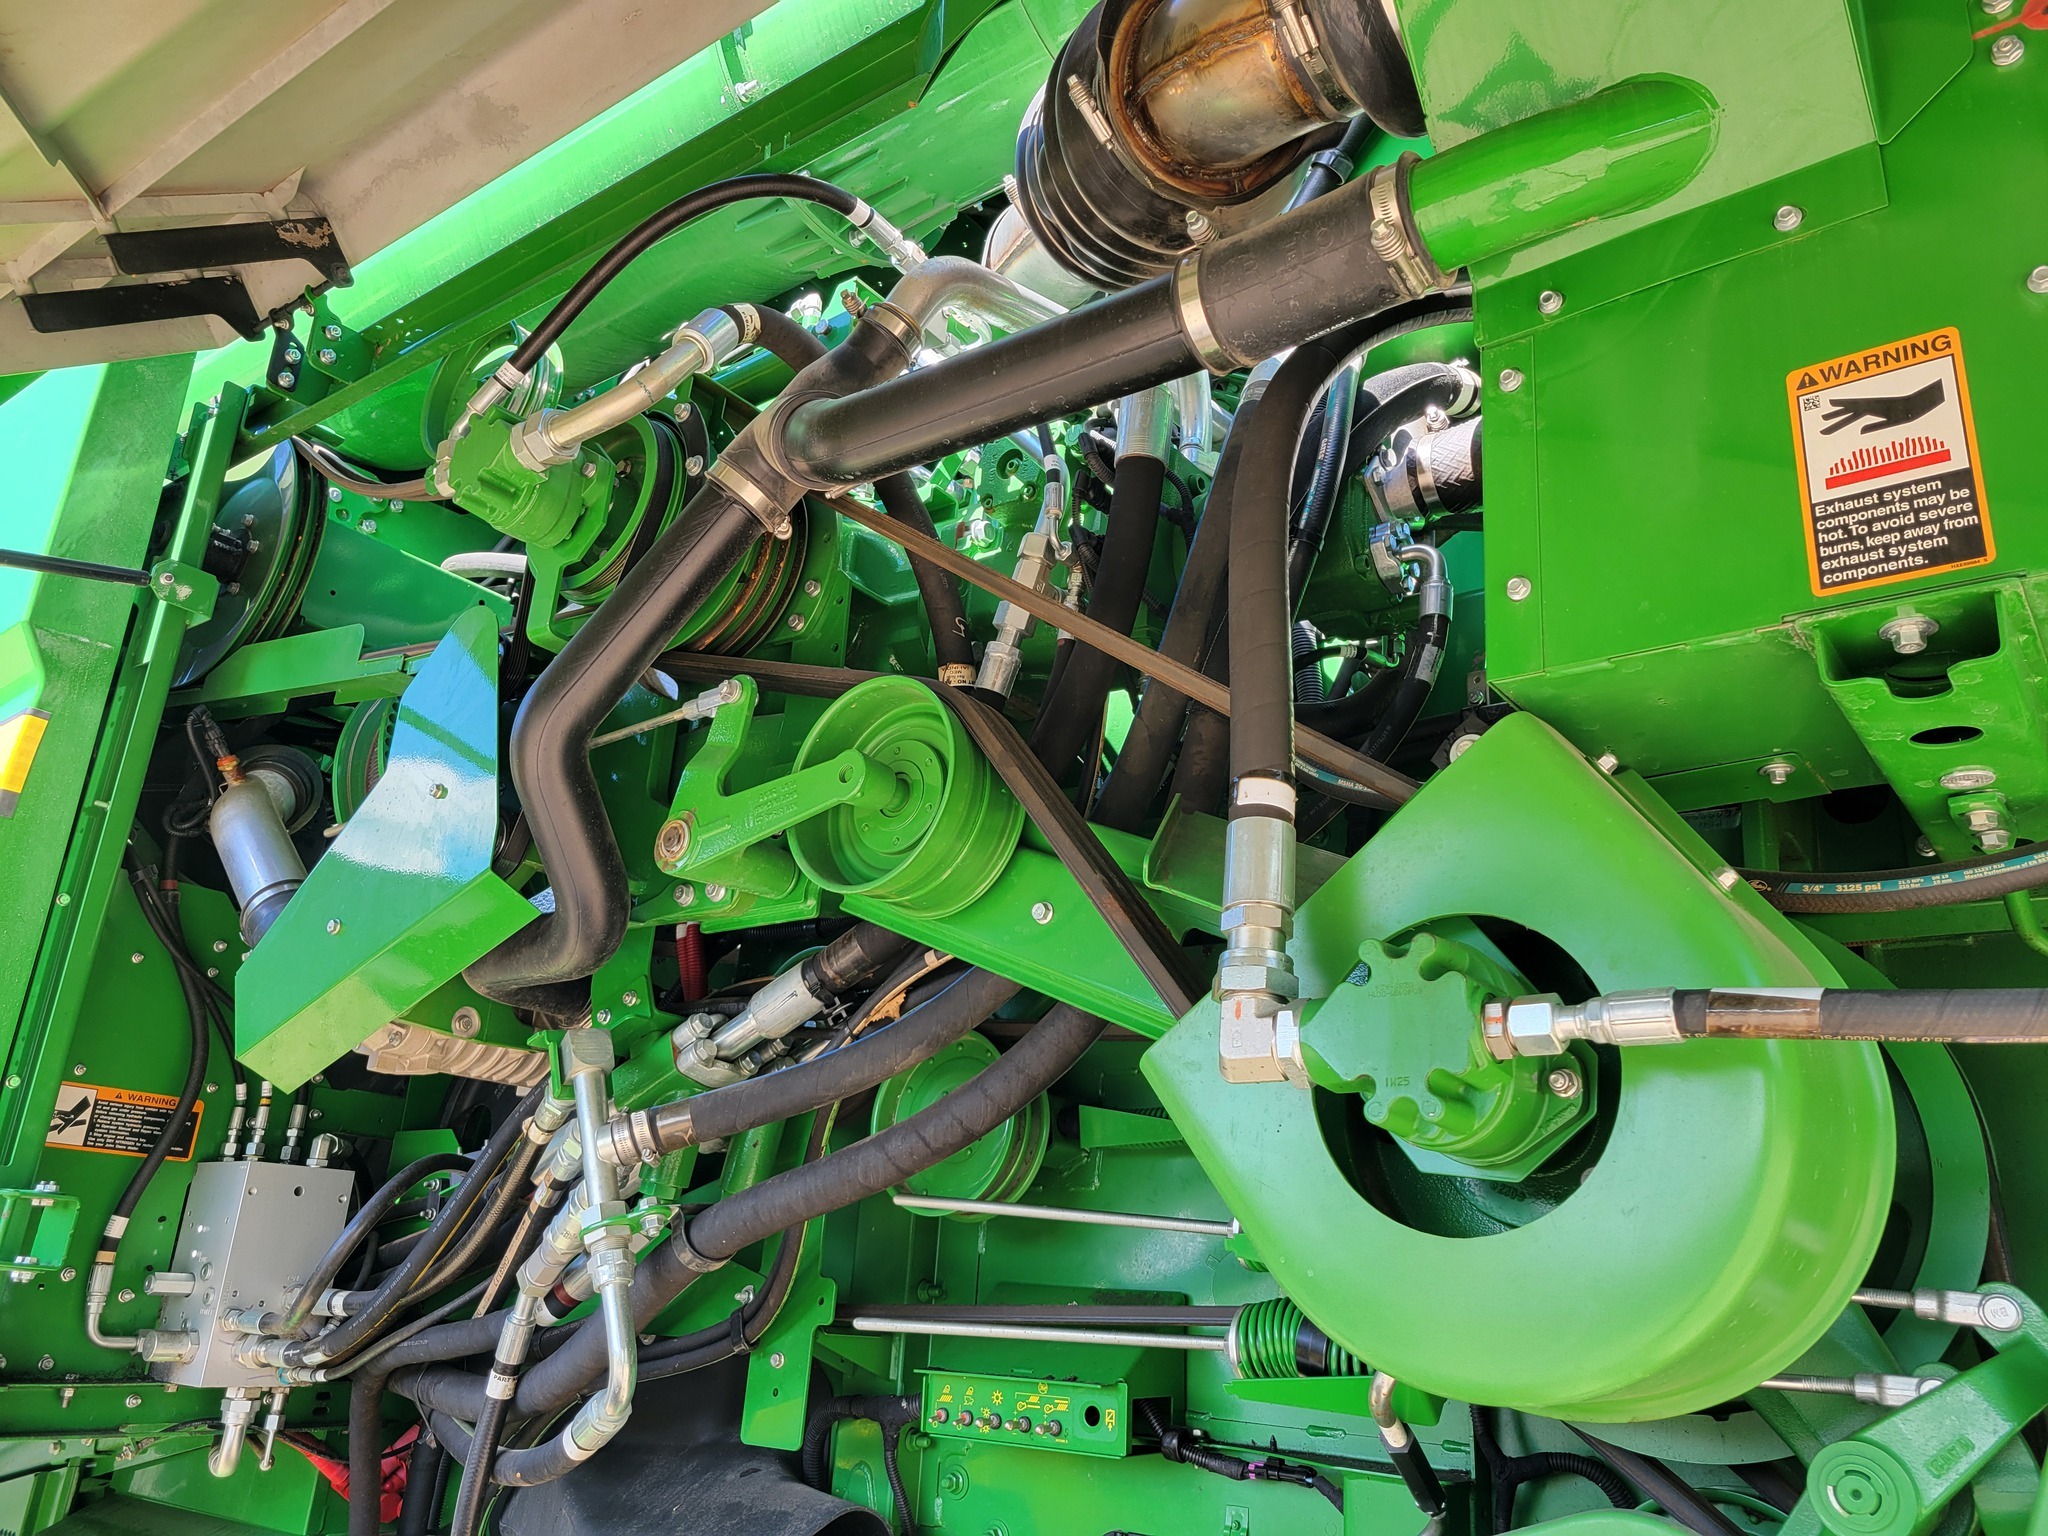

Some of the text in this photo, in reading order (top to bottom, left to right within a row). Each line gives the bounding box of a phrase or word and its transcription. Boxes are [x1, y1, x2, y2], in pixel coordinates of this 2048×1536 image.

[1818, 334, 1952, 383] WARNING
[1815, 480, 1941, 516] Exhaust system
[1817, 488, 1969, 529] components may be
[1818, 502, 1972, 542] hot. To avoid severe
[1820, 515, 1978, 556] burns, keep away from
[1821, 536, 1947, 569] exhaust system
[1823, 556, 1928, 582] components.
[1983, 864, 2021, 875] Performance
[1835, 883, 1862, 892] 3125
[1864, 882, 1881, 891] psi
[128, 1093, 177, 1106] WARNING
[493, 1375, 512, 1383] PART
